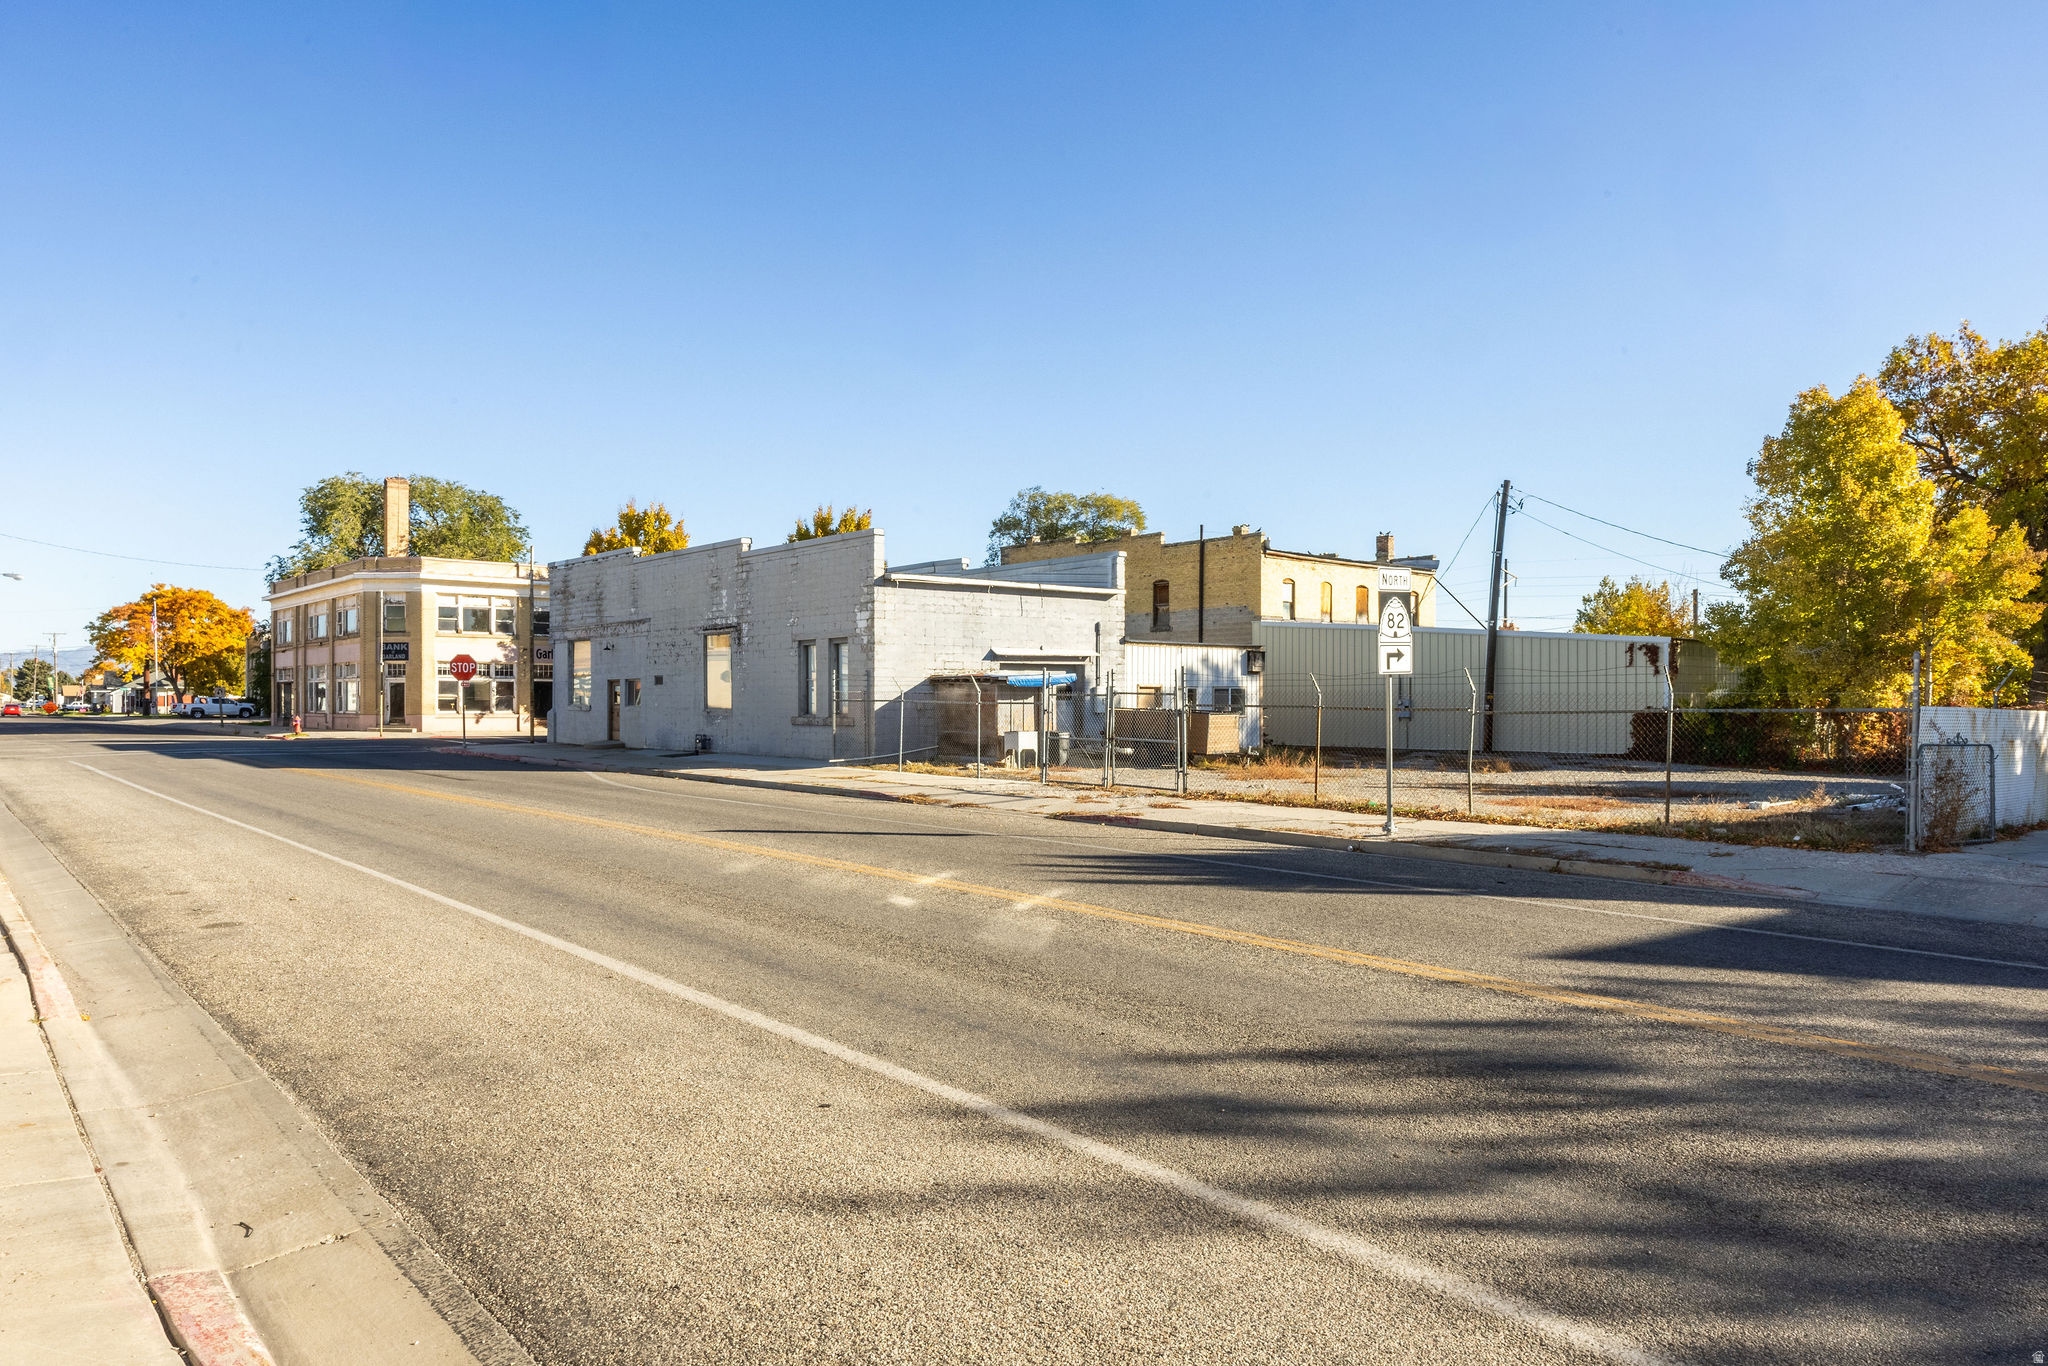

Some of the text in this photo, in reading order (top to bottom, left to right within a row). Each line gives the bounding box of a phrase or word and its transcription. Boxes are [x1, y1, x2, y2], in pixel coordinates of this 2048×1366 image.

[1382, 573, 1408, 586] NORTH
[1387, 612, 1405, 629] 82
[451, 662, 476, 673] STOP
